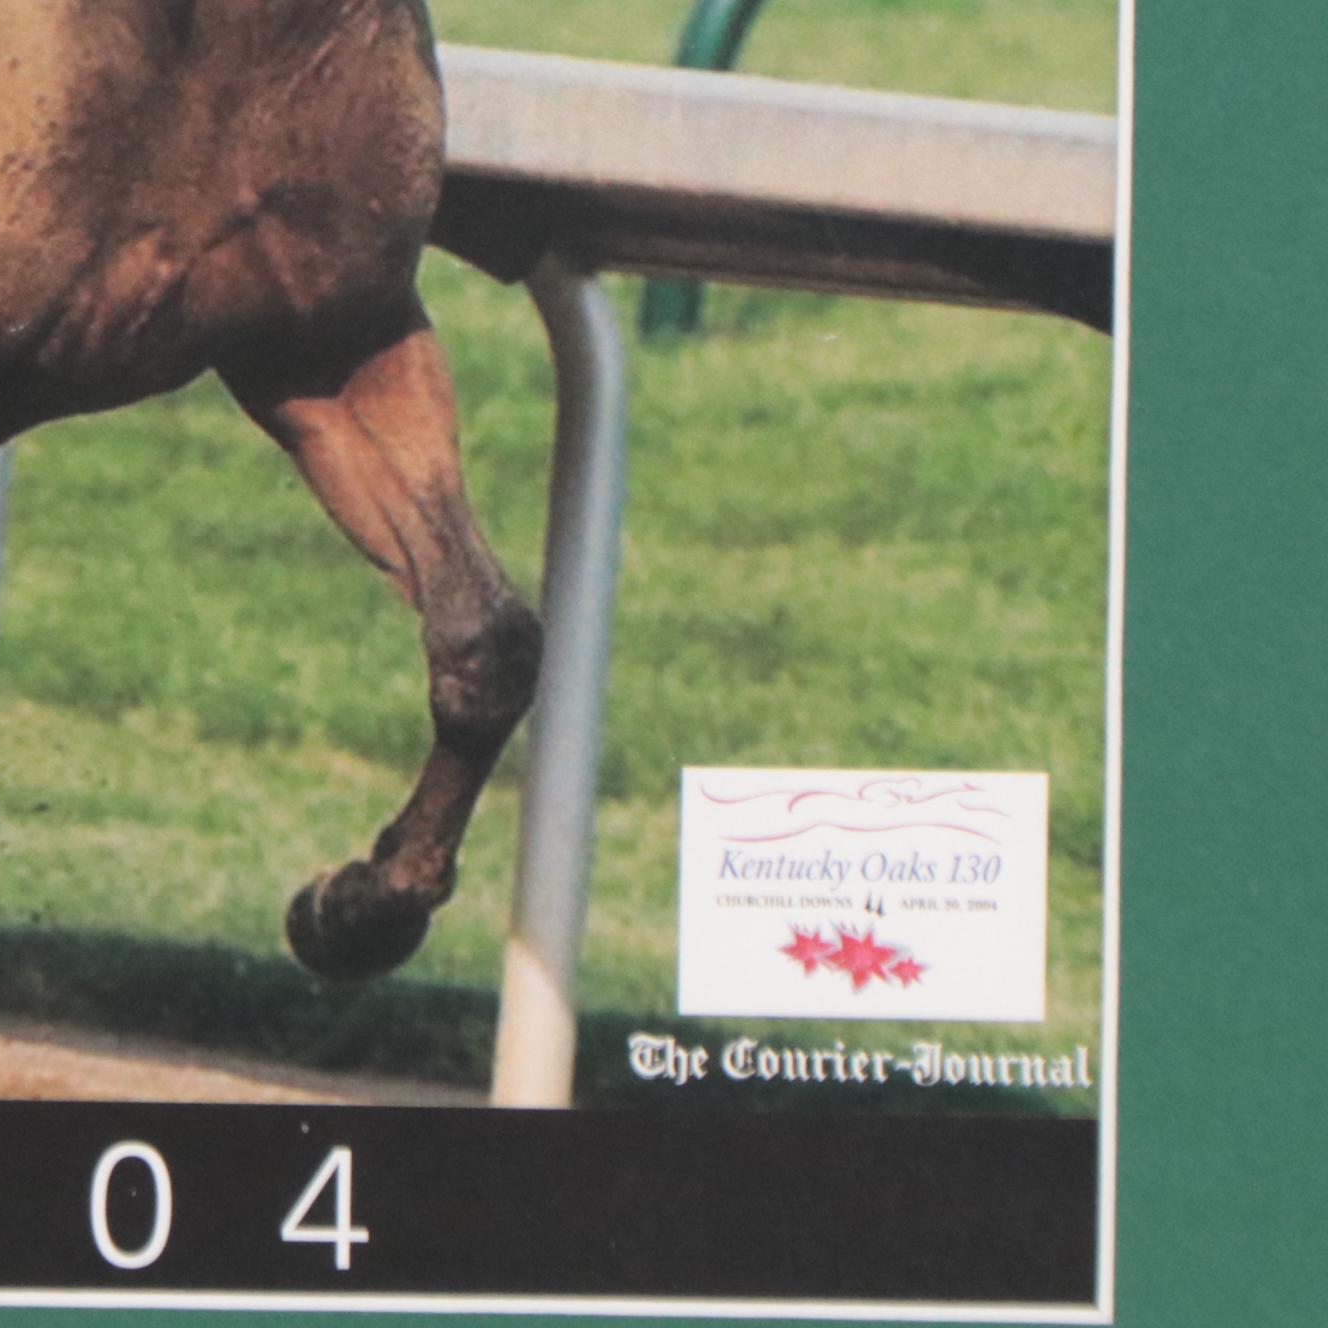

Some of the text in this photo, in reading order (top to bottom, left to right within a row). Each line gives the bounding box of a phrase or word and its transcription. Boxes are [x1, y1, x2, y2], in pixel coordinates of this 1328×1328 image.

[718, 848, 1003, 892] Kentucky Oaks 130
[716, 894, 854, 909] CHURCHILL DOWNS
[900, 898, 938, 911] APRIL
[628, 1031, 1094, 1089] The Courier-Journal
